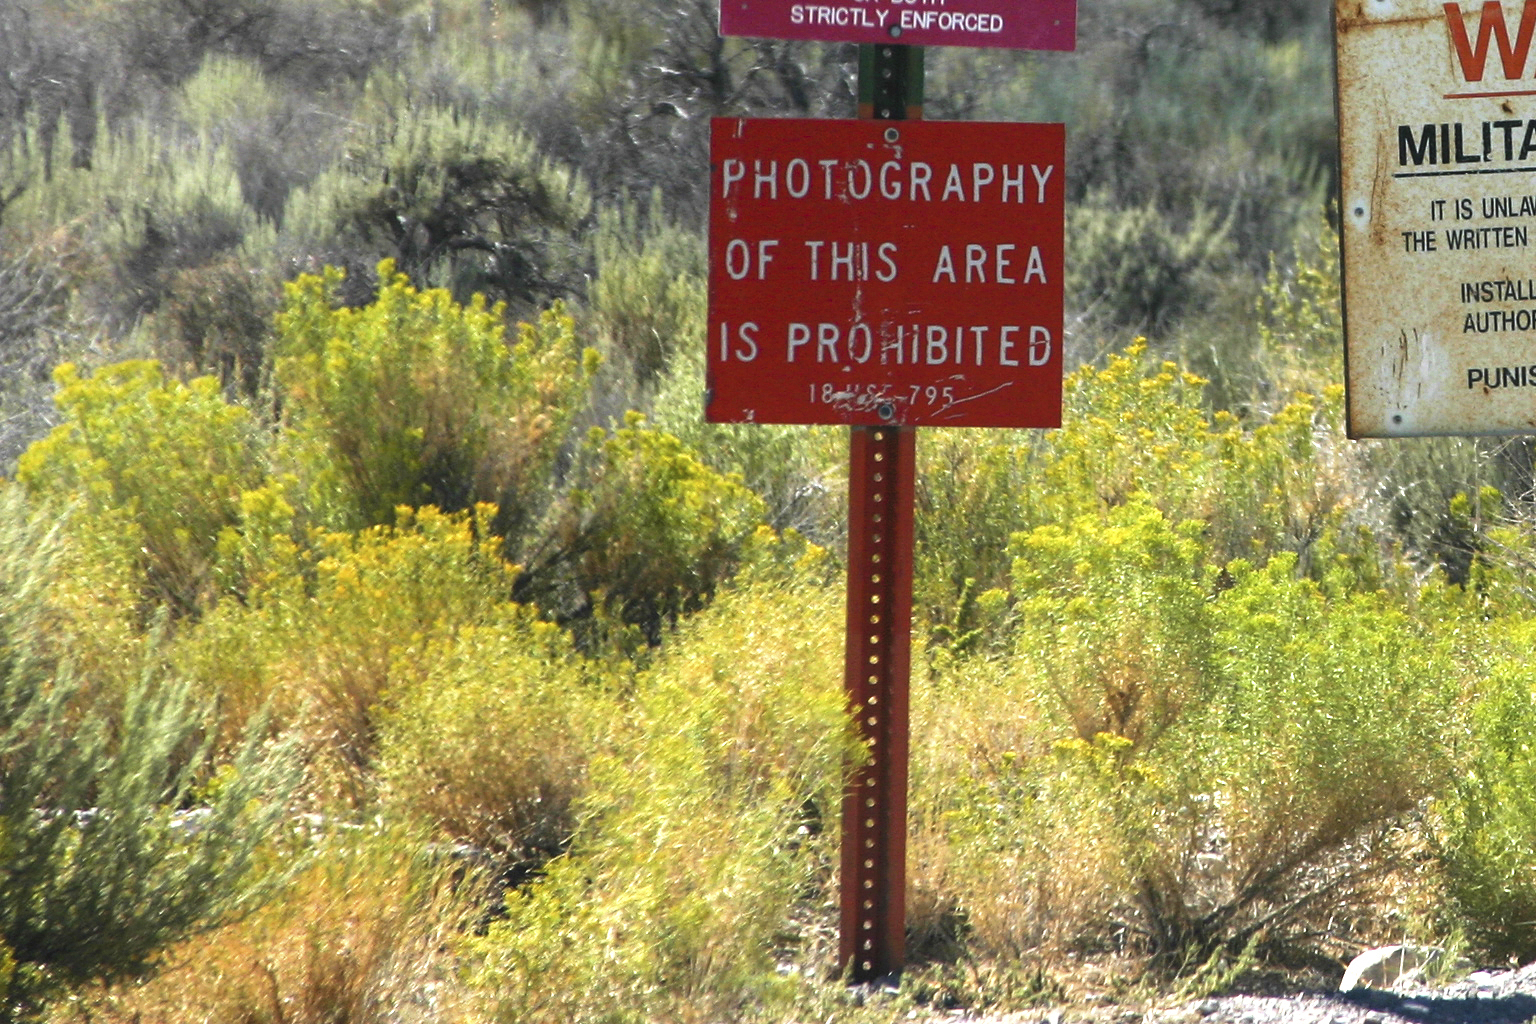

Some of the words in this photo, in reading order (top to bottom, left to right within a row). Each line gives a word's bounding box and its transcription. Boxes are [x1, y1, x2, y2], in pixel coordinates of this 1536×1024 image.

[791, 5, 889, 27] STRICTLY
[901, 10, 1003, 32] ENFORCED
[723, 158, 1053, 203] PHOTOGRAPHY
[1432, 200, 1446, 221] IT
[1455, 199, 1472, 220] IS
[1401, 231, 1437, 252] THE
[1446, 226, 1527, 250] WRITTEN
[726, 239, 779, 280] OF
[805, 241, 897, 282] THIS
[933, 244, 1046, 284] AREA
[721, 322, 758, 362] IS
[788, 323, 1051, 366] PROHIBITED
[810, 383, 832, 403] 18
[909, 385, 954, 404] 795
